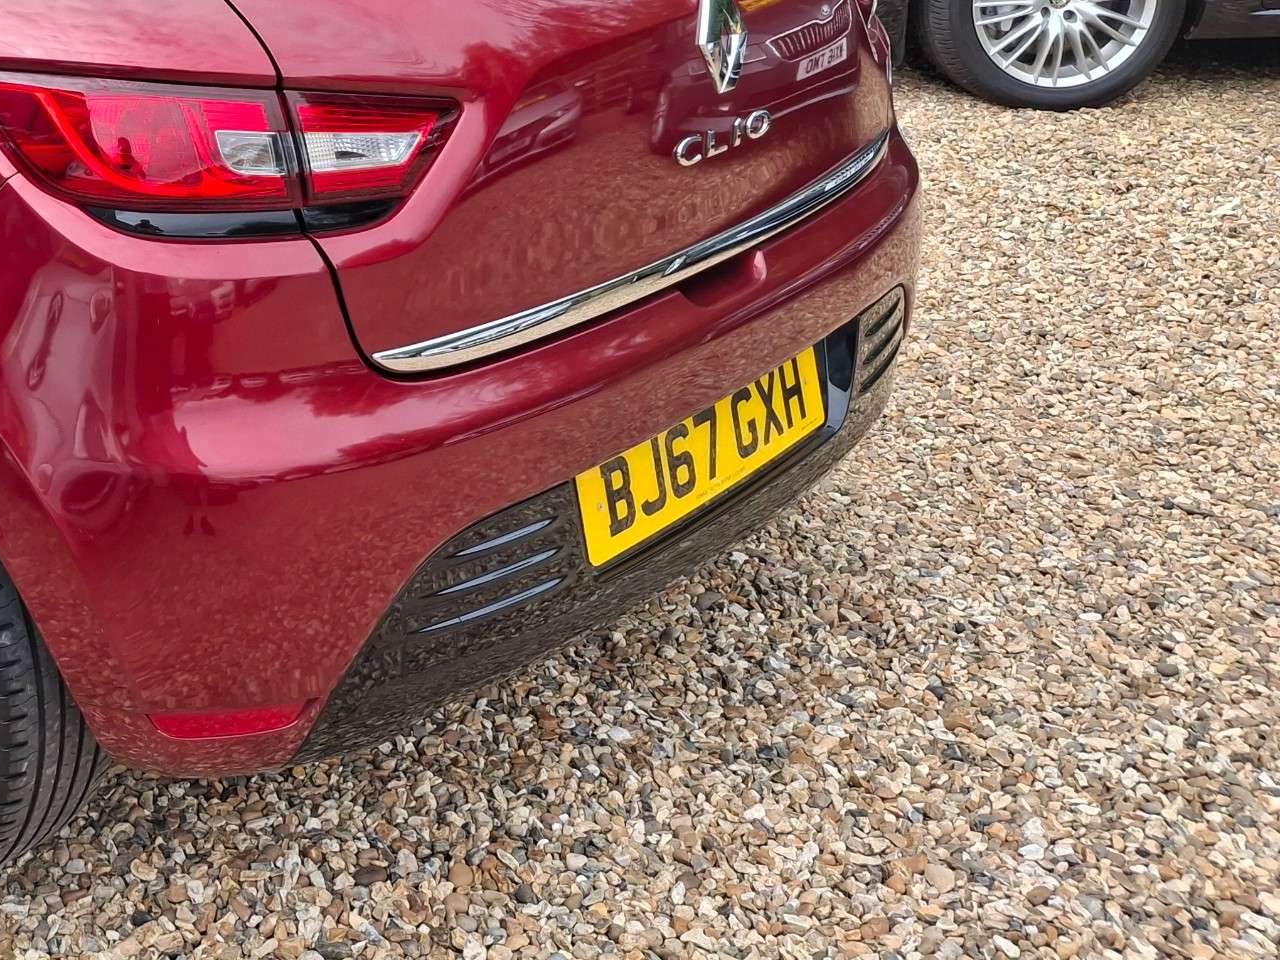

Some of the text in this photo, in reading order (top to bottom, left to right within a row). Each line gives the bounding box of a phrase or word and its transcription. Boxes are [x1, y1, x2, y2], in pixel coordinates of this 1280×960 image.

[672, 109, 771, 168] CLIO
[599, 357, 807, 539] BJ67 GXH
